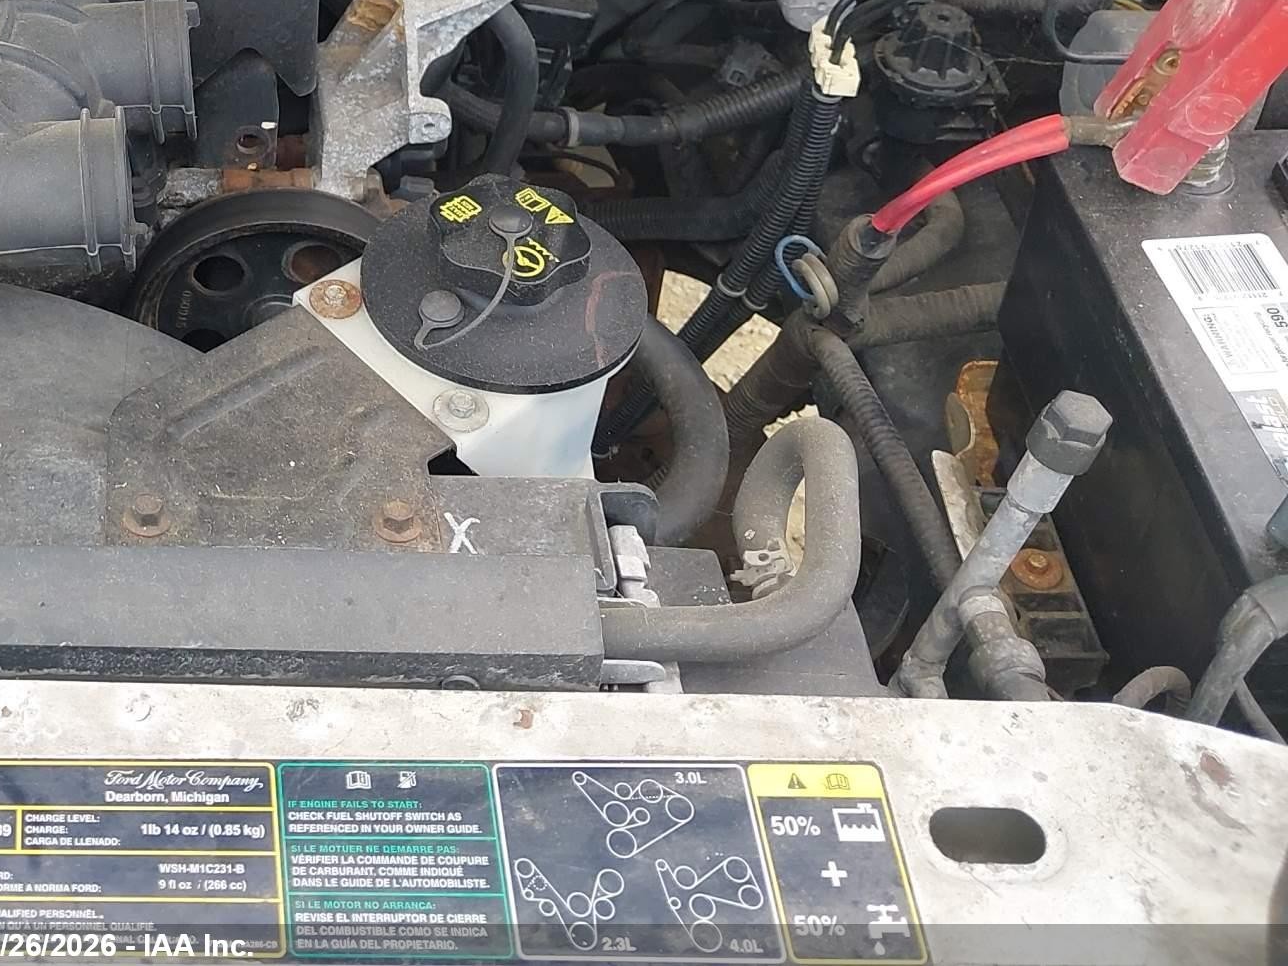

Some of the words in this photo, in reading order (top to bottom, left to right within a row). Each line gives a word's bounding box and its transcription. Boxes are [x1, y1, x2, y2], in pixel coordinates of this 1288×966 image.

[1266, 307, 1288, 328] 590
[104, 770, 143, 785] Ford
[135, 771, 188, 789] Motor
[185, 770, 264, 792] Company
[675, 772, 707, 784] 3.0L
[105, 791, 169, 803] Dearborn,
[172, 792, 230, 805] Michigan
[25, 814, 66, 823] CHARGE
[67, 814, 100, 823] LEVEL:
[288, 812, 325, 820] CHECK
[326, 812, 354, 820] FUEL
[355, 812, 402, 821] SHUTOFF
[404, 812, 446, 821] SWITCH
[447, 812, 462, 821] AS
[25, 825, 68, 834] CHARGE:
[165, 824, 180, 835] 14
[181, 827, 198, 835] oz
[208, 824, 242, 837] (0.85
[243, 824, 266, 838] kg)
[289, 824, 359, 832] REFERENCED
[361, 824, 372, 832] IN
[373, 824, 404, 833] YOUR
[405, 824, 445, 833] OWNER
[447, 824, 483, 833] GUIDE.
[771, 816, 821, 836] 50%
[24, 837, 58, 845] CARGA
[59, 837, 73, 846] DE
[74, 837, 121, 846] LLENADO:
[303, 845, 317, 853] LE
[366, 845, 381, 853] NE
[341, 855, 356, 864] LA
[357, 855, 416, 864] COMMANDE
[418, 856, 432, 864] DE
[433, 856, 489, 864] COUPURE
[292, 867, 306, 875] DE
[378, 867, 419, 876] COMME
[420, 866, 464, 877] INDIQUÉ
[158, 880, 166, 890] 9
[179, 882, 193, 890] oz
[203, 880, 228, 892] (266
[229, 881, 247, 892] cc)
[293, 878, 322, 887] DANS
[324, 879, 338, 887] LE
[339, 879, 373, 887] GUIDE
[375, 879, 390, 887] DE
[393, 879, 490, 888] L'AUTOMOBILISTE.
[34, 884, 70, 893] NORMA
[72, 885, 102, 893] FORD:
[308, 901, 321, 909] LE
[323, 901, 362, 909] MOTOR
[364, 901, 379, 909] NO
[295, 914, 333, 922] REVISE
[336, 914, 350, 922] EL
[352, 914, 428, 923] INTERRUPTOR
[429, 914, 444, 923] DE
[446, 914, 487, 924] CIERRE
[794, 915, 846, 936] 50%
[296, 926, 317, 935] DEL
[319, 926, 396, 936] COMBUSTIBLE
[397, 927, 432, 936] COMO
[435, 927, 449, 936] SE
[450, 927, 488, 936] INDICA
[297, 939, 312, 948] EN
[314, 939, 329, 948] LA
[359, 940, 381, 949] DEL
[383, 940, 459, 950] PROPIETARIO.
[601, 937, 637, 951] 2.3L
[730, 939, 764, 953] 4.0L
